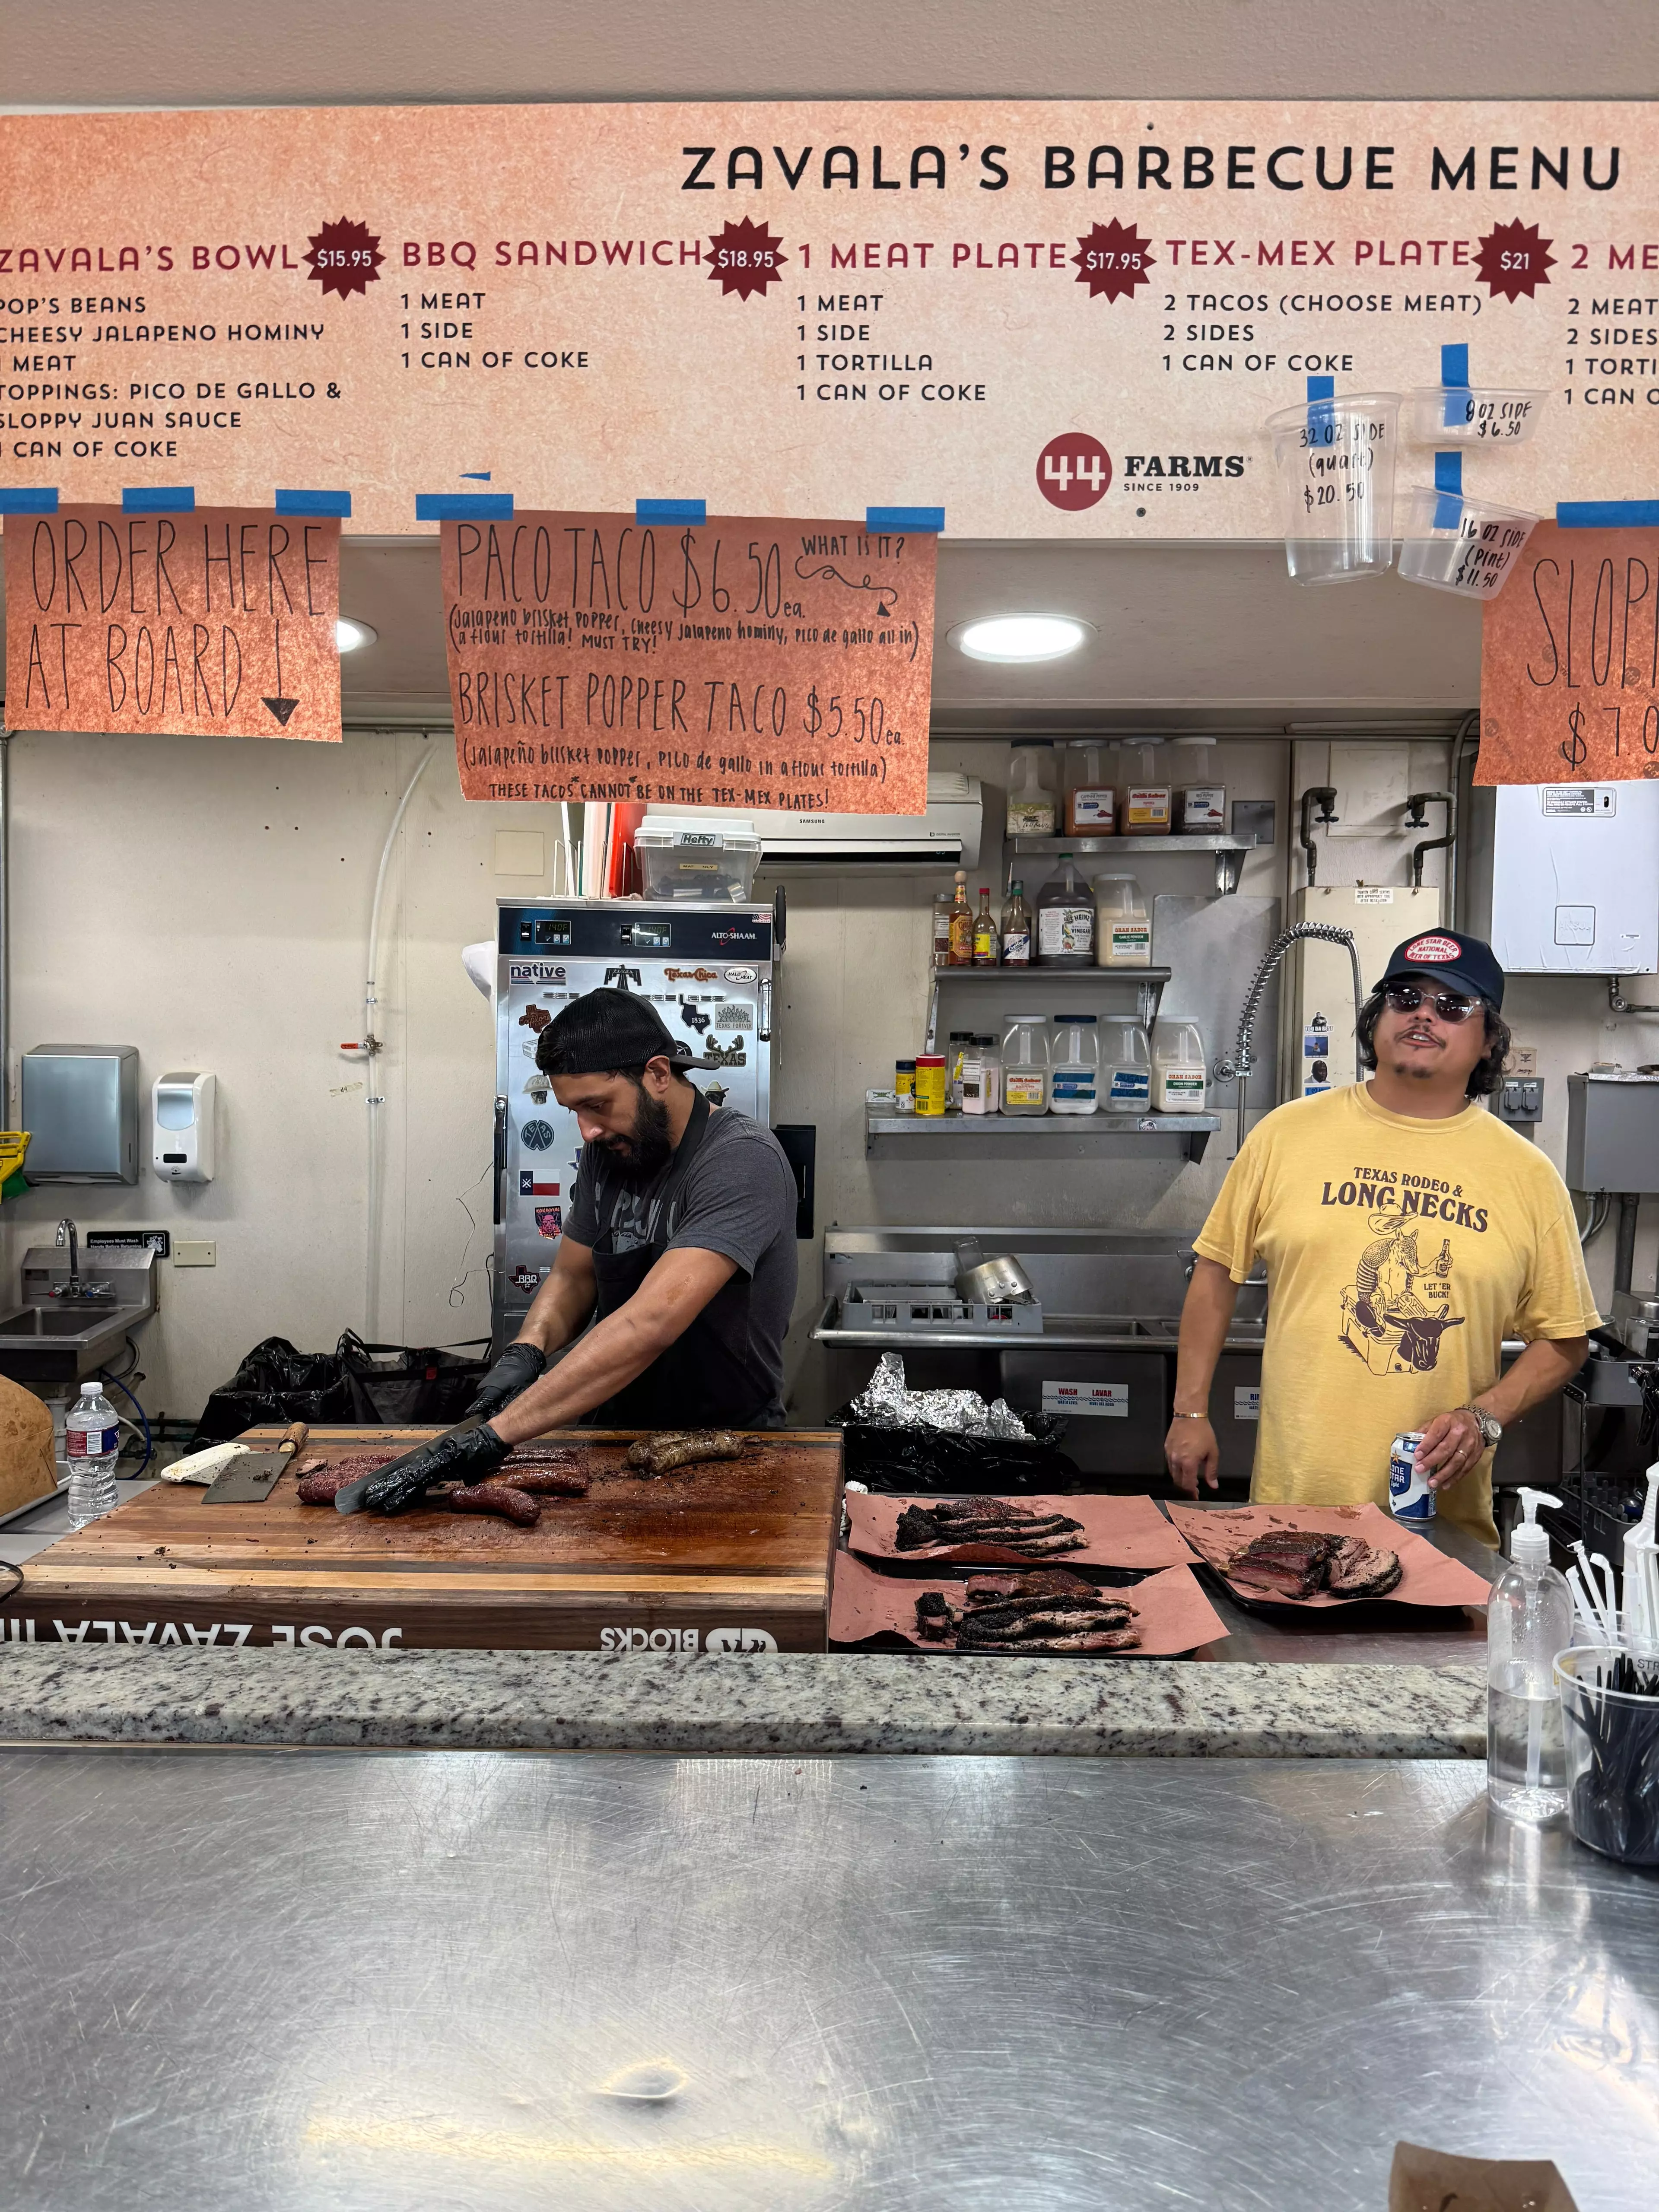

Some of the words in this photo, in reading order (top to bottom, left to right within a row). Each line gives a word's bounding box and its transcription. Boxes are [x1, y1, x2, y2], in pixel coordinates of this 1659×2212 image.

[681, 145, 1009, 191] ZAVALA'S
[1044, 145, 1396, 191] BARBECUE
[1431, 146, 1620, 191] MENU
[192, 244, 299, 271] BOWL
[317, 249, 372, 268] $15.95
[403, 241, 477, 271] BBQ
[496, 239, 701, 267] SANDWICH
[718, 250, 774, 269] $18.95
[798, 243, 810, 268] 1
[832, 242, 934, 269] MEAT
[953, 242, 1067, 268] PLATE
[1086, 253, 1141, 271] $17.95
[1166, 240, 1335, 267] TEX-MEX
[1355, 240, 1469, 266] PLATE
[1500, 252, 1529, 271] $21
[1571, 244, 1588, 269] 2
[1608, 244, 1659, 270] ME
[70, 296, 146, 313] BEANS
[1164, 295, 1176, 311] 2
[1187, 295, 1268, 312] TACOS
[1279, 295, 1392, 315] (CHOOSE
[1404, 295, 1481, 316] MEAT)
[0, 326, 83, 343] CHEESY
[92, 324, 216, 343] JALAPENO
[228, 324, 325, 341] HOMINY
[401, 324, 408, 339] 1
[421, 322, 473, 339] SIDE
[401, 353, 410, 369] 1
[421, 352, 470, 369] CAN
[482, 352, 513, 368] OF
[524, 352, 589, 369] COKE
[797, 355, 805, 371] 1
[817, 355, 933, 372] TORTILLA
[130, 383, 184, 400] PICO
[197, 383, 226, 399] DE
[237, 382, 315, 399] GALLO
[327, 382, 341, 399] &
[92, 413, 154, 429] JUAN
[165, 411, 242, 428] SAUCE
[1500, 401, 1532, 420] SIDE
[1300, 428, 1318, 447] 32
[1354, 423, 1384, 441] SIDE
[1478, 420, 1521, 437] $6.50
[1044, 456, 1105, 491] 44
[1124, 456, 1244, 477] FARMS
[1124, 483, 1162, 492] SINCE
[1170, 483, 1199, 492] 1909
[1304, 482, 1364, 513] $20.50
[1461, 518, 1478, 539] 16
[1500, 528, 1526, 549] SIDE
[801, 535, 848, 556] WHAT
[858, 534, 869, 556] IS
[878, 536, 905, 565] IT?
[32, 520, 183, 615] ORDER
[205, 524, 327, 616] HERE
[458, 524, 551, 603] PACO
[564, 528, 655, 613] TACO
[672, 528, 781, 619] $6.50
[1456, 565, 1498, 588] $11.50
[582, 634, 616, 650] MUST
[622, 636, 656, 654] TRY!
[25, 623, 83, 709] AT
[107, 623, 242, 717] BOARD
[459, 672, 569, 729] BRISKET
[587, 673, 688, 733] POPPER
[704, 681, 786, 737] TACO
[803, 685, 884, 745] $5.50
[489, 783, 529, 798] THESE
[534, 784, 574, 799] TACOS
[580, 783, 632, 799] CANNOT
[637, 785, 652, 799] BE
[659, 785, 675, 800] ON
[680, 788, 702, 803] THE
[712, 788, 771, 804] TEX-MEX
[779, 789, 829, 809] PLATES!
[683, 835, 713, 845] Hefty
[1410, 940, 1424, 951] LONE
[1443, 940, 1457, 952] BEER
[511, 963, 566, 977] native
[705, 1054, 745, 1066] TEXAS
[1354, 1167, 1398, 1184] TEXAS
[1401, 1173, 1449, 1194] RODEO
[1452, 1185, 1463, 1198] &
[1321, 1182, 1395, 1208] LONG
[1402, 1190, 1488, 1233] NECKS
[518, 1275, 537, 1283] BBQ
